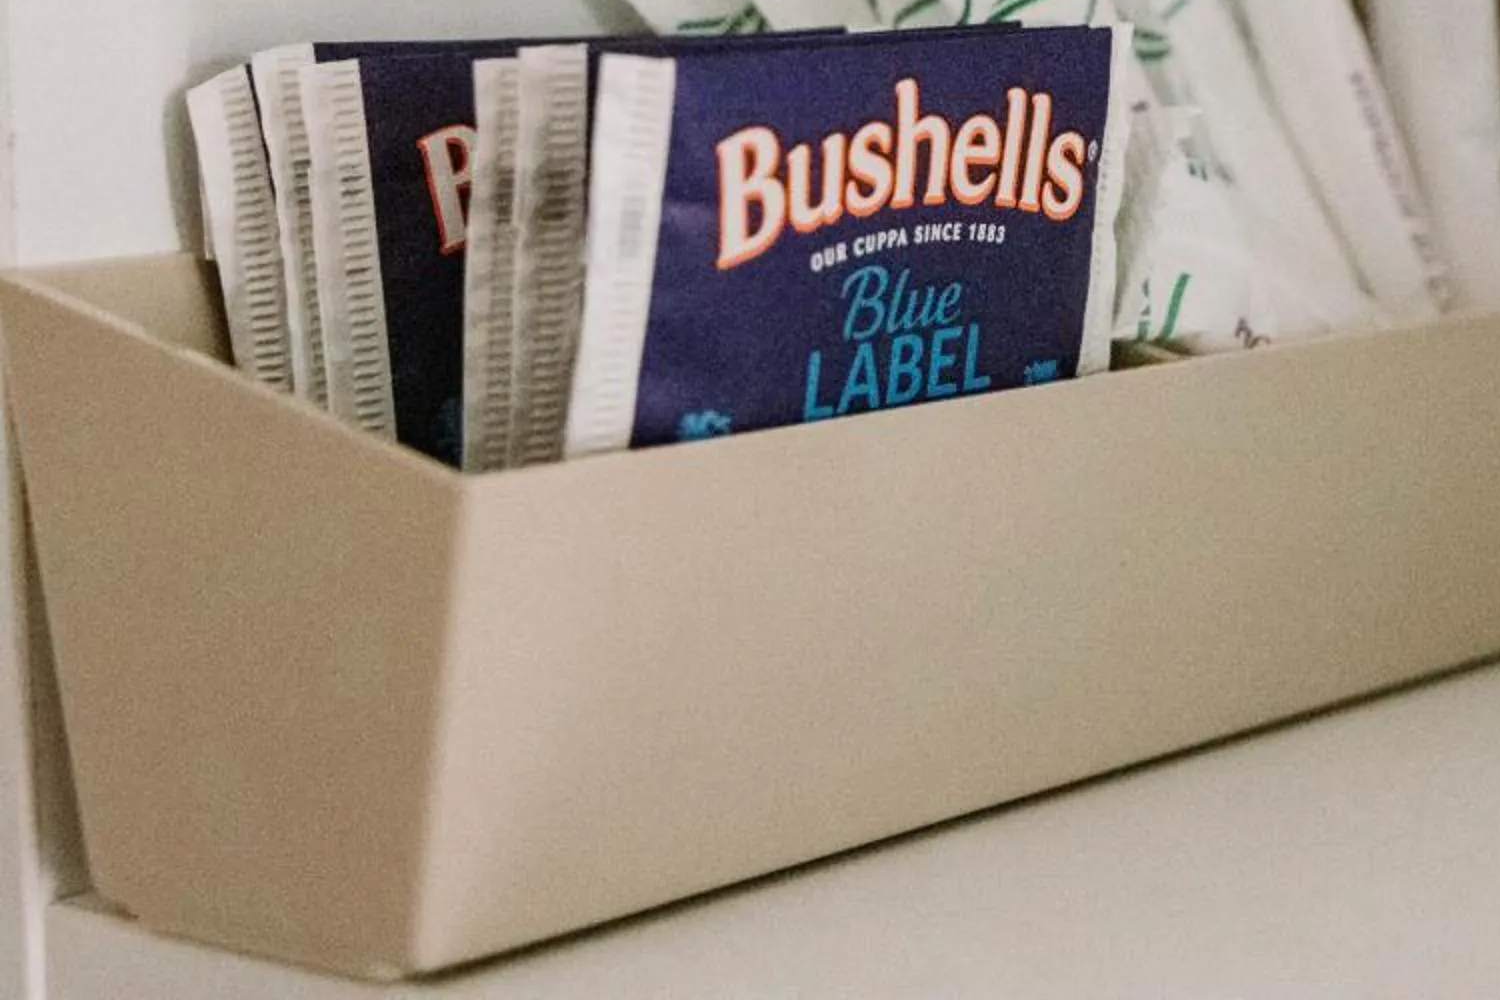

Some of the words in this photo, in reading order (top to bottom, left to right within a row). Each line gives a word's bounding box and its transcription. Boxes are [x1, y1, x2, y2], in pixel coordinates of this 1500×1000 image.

[714, 76, 1086, 271] Bushells
[809, 242, 848, 272] OUR
[853, 227, 909, 258] CUPPA
[913, 222, 963, 245] SINCE
[968, 222, 1006, 244] 1883
[841, 264, 963, 341] Blue
[803, 322, 992, 424] LABEL
